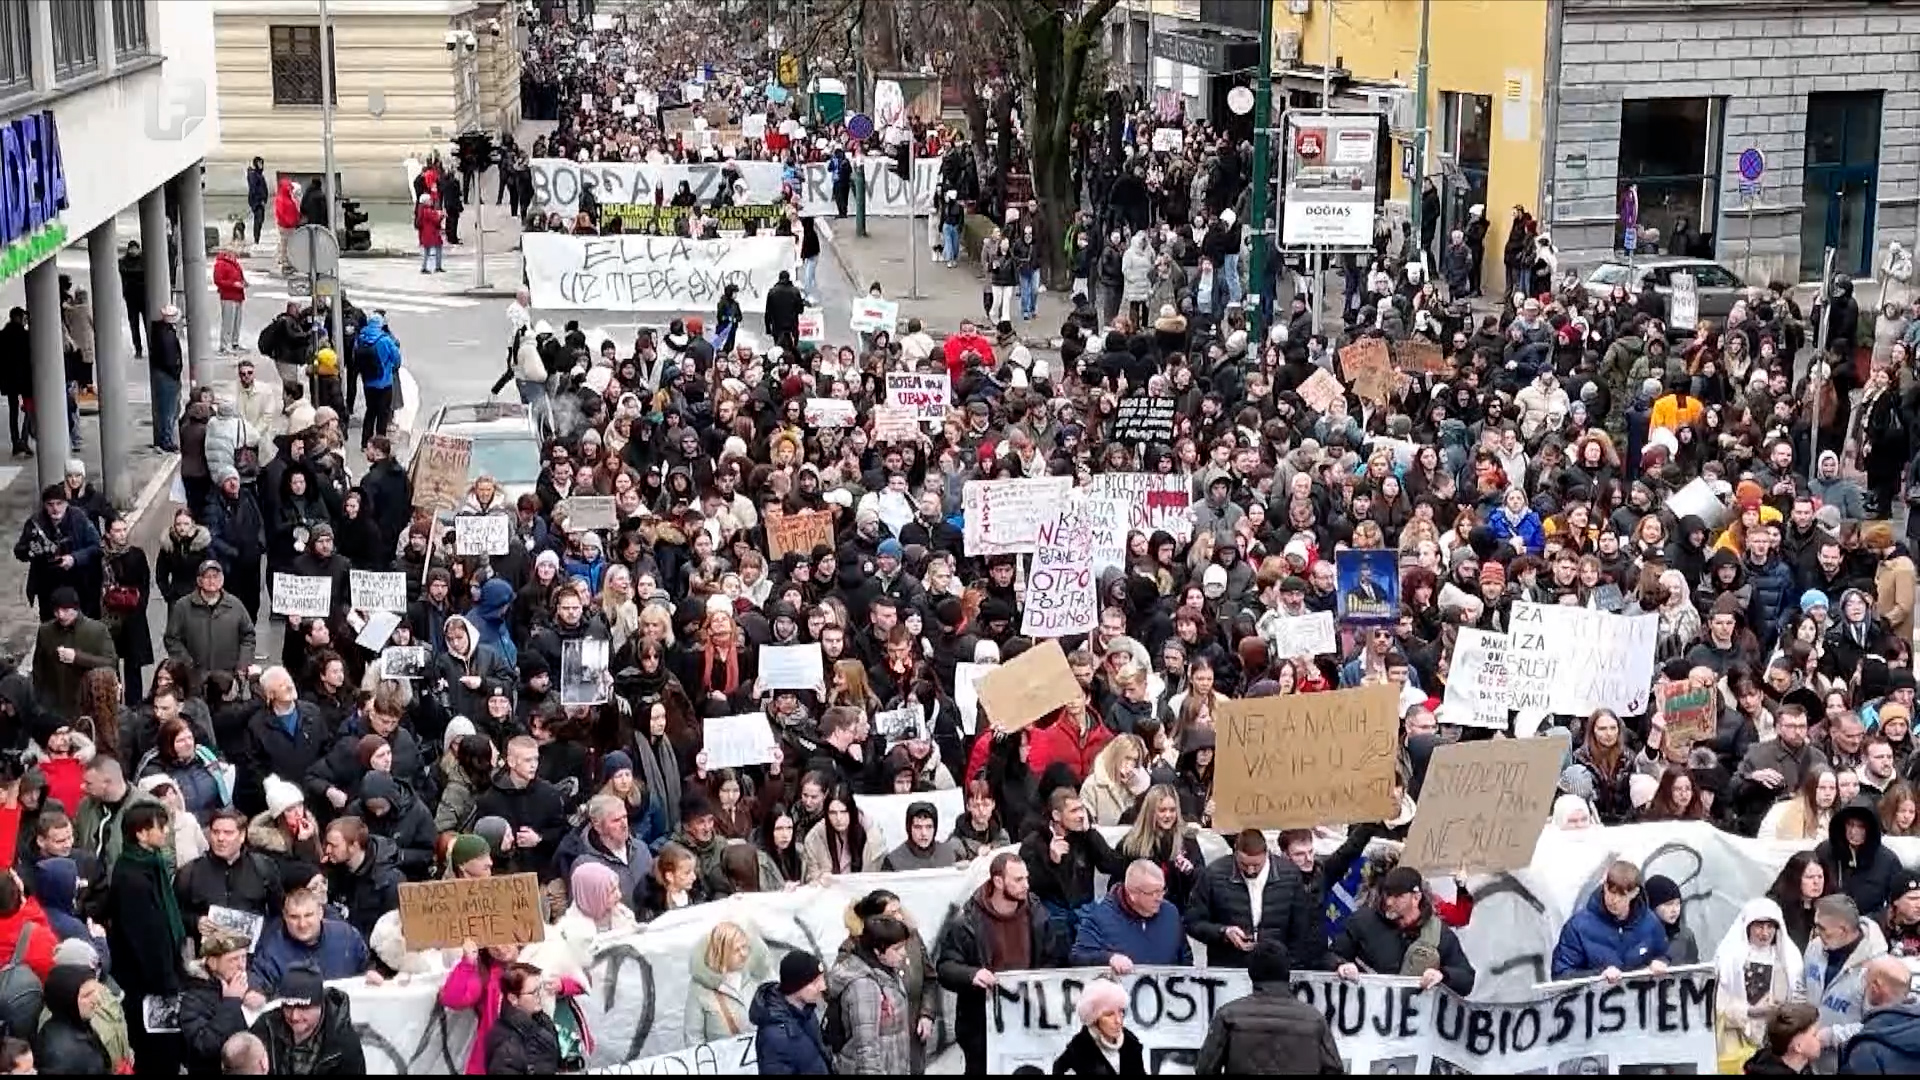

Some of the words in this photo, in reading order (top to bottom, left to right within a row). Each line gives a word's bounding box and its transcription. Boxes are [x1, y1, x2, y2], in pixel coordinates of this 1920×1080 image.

[584, 239, 692, 269] ELLA
[605, 268, 684, 304] TEBE
[1515, 606, 1543, 623] ZA
[1521, 634, 1545, 650] ZA
[1421, 818, 1465, 863] NE
[1371, 986, 1419, 1037] JE
[1436, 993, 1540, 1055] UBIO
[1548, 976, 1716, 1043] SISTEM
